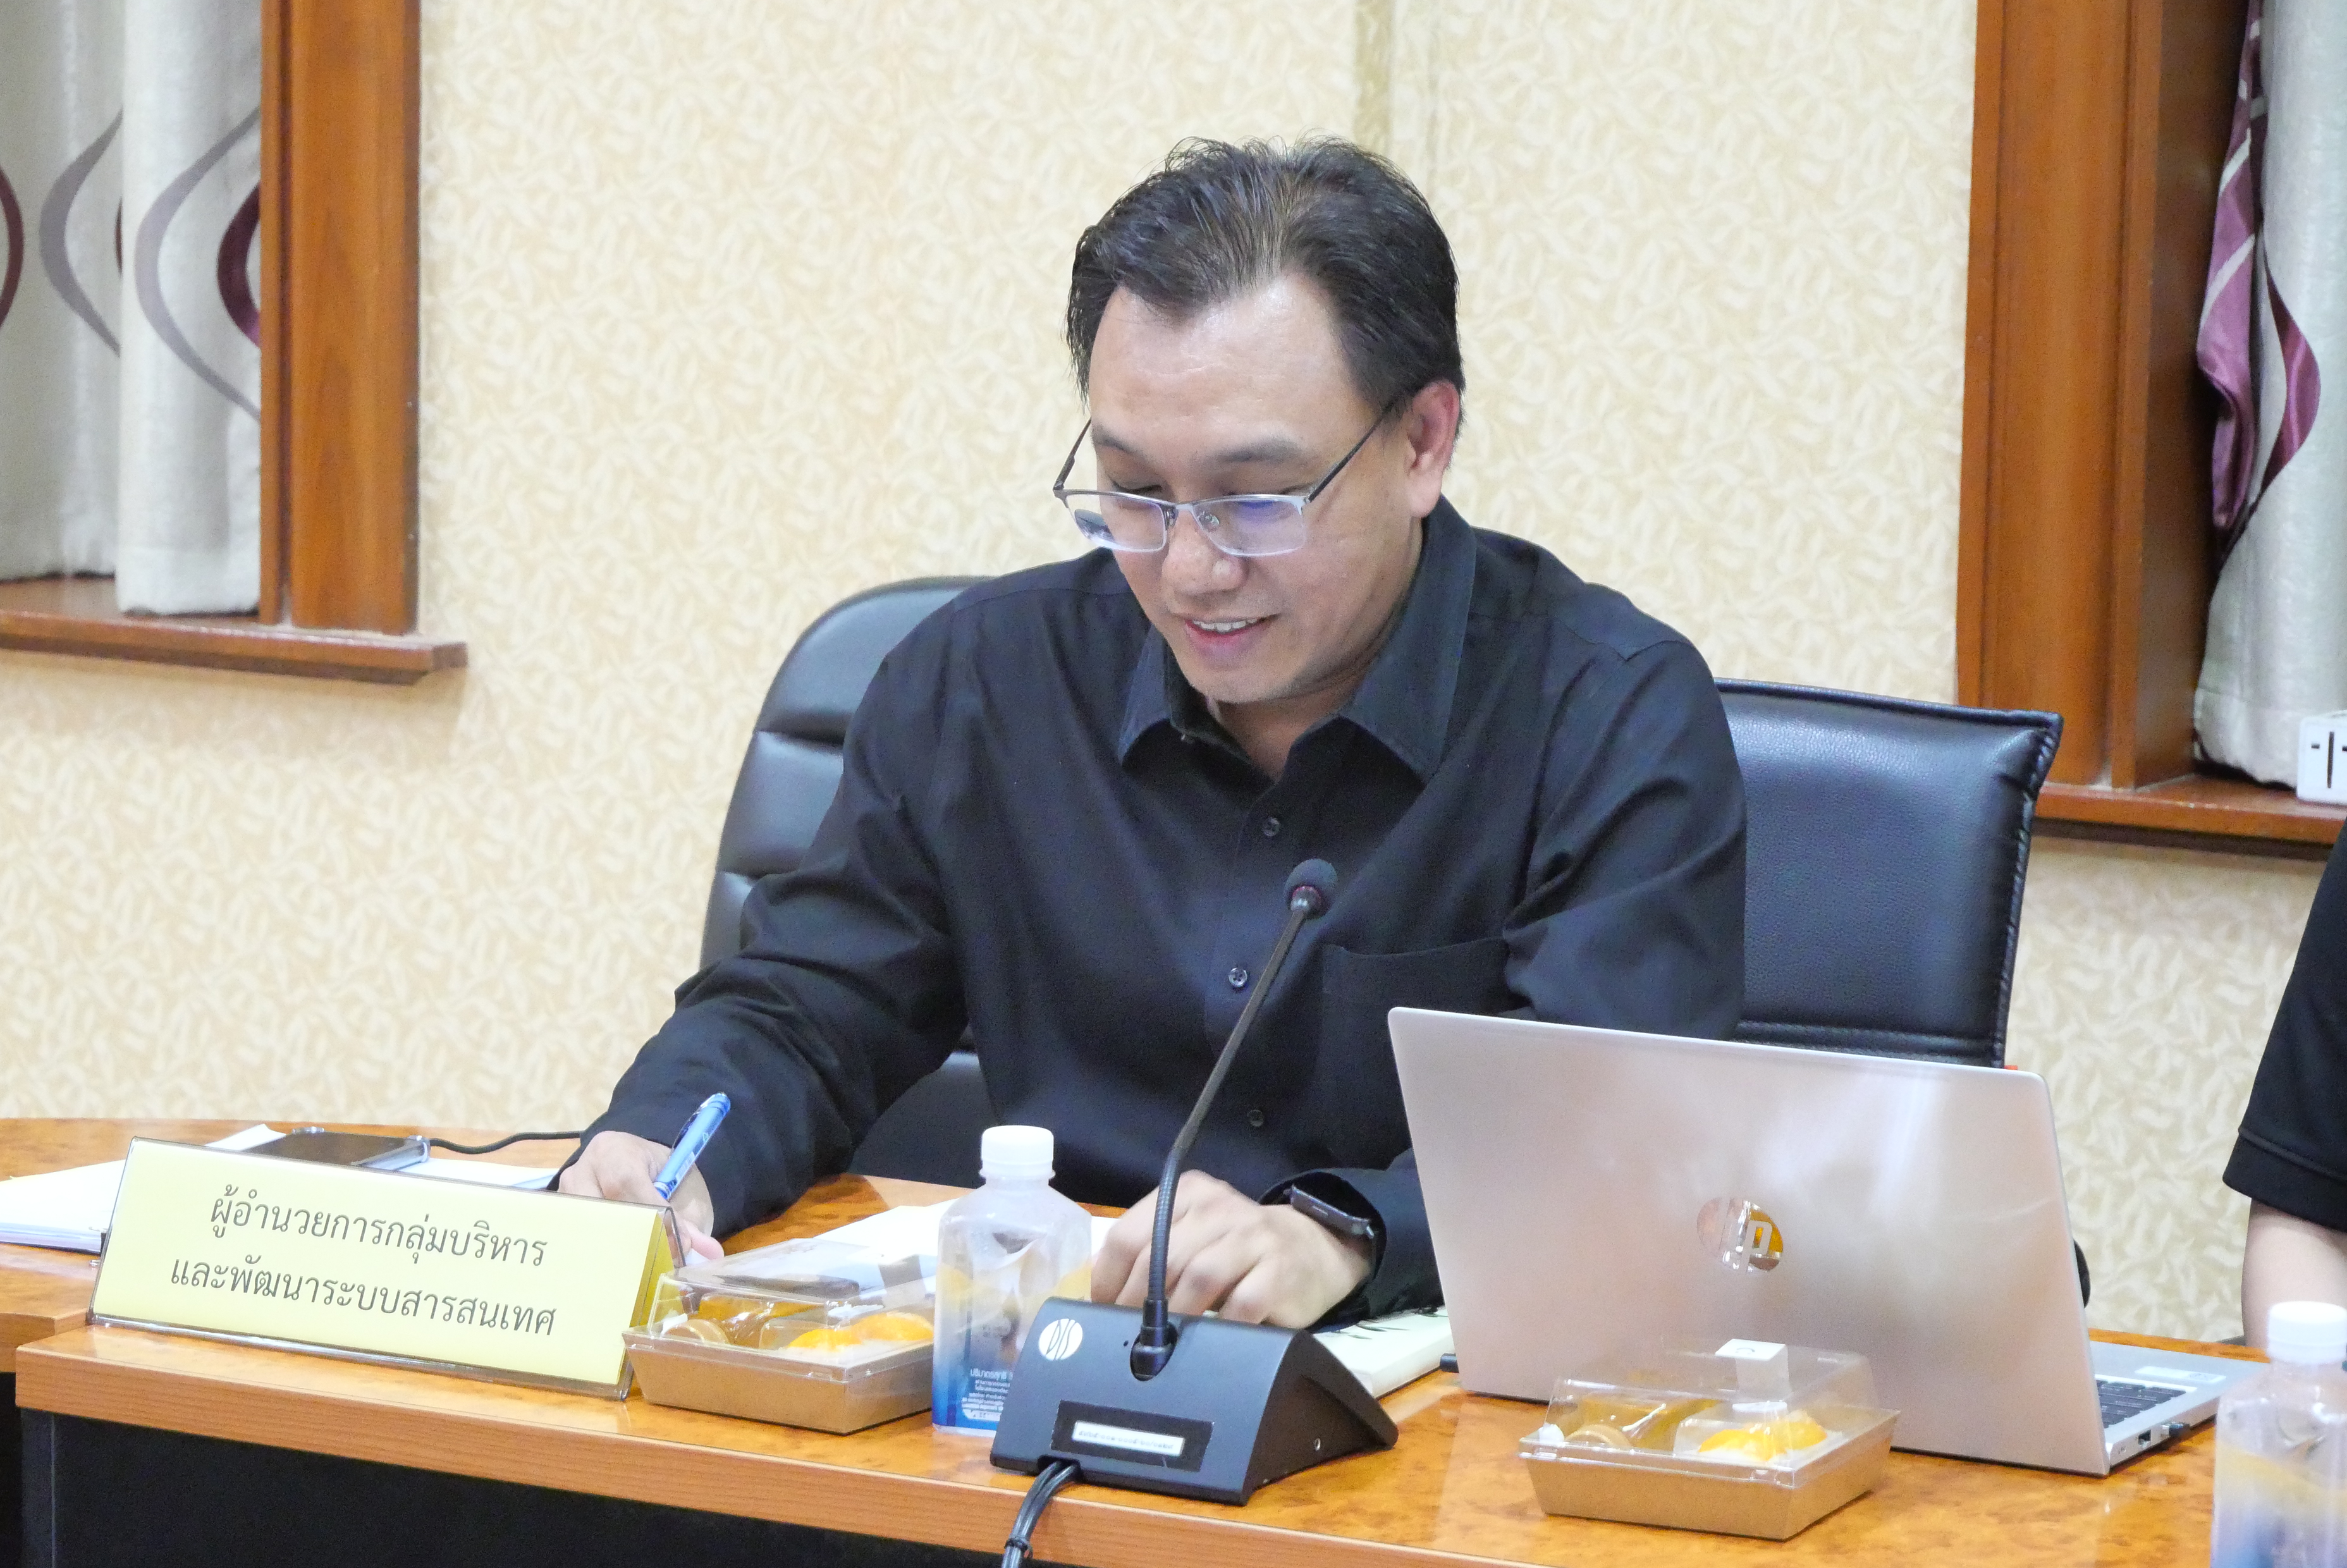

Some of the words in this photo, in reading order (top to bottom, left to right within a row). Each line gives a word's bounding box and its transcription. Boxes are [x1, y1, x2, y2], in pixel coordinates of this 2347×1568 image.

[211, 1184, 548, 1267] ผู้อำนวยการกลุ่มบริหาร
[170, 1254, 556, 1336] และพัฒนาระบบสารสนเทศ
